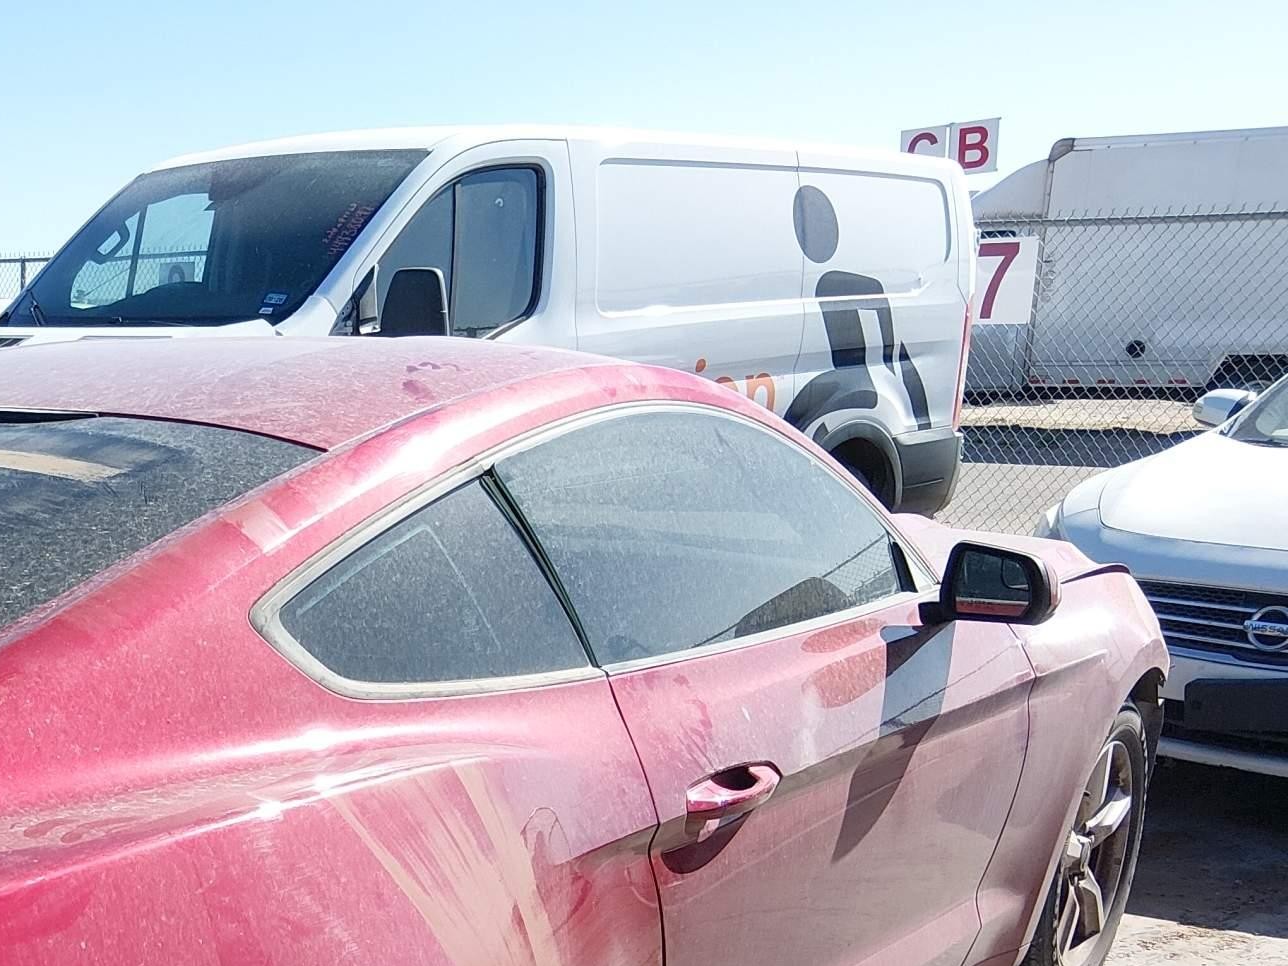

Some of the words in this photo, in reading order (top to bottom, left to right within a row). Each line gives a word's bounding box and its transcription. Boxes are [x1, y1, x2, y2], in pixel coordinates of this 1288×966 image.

[957, 125, 990, 170] B
[977, 241, 1021, 320] 7
[1248, 623, 1288, 634] NISSA
